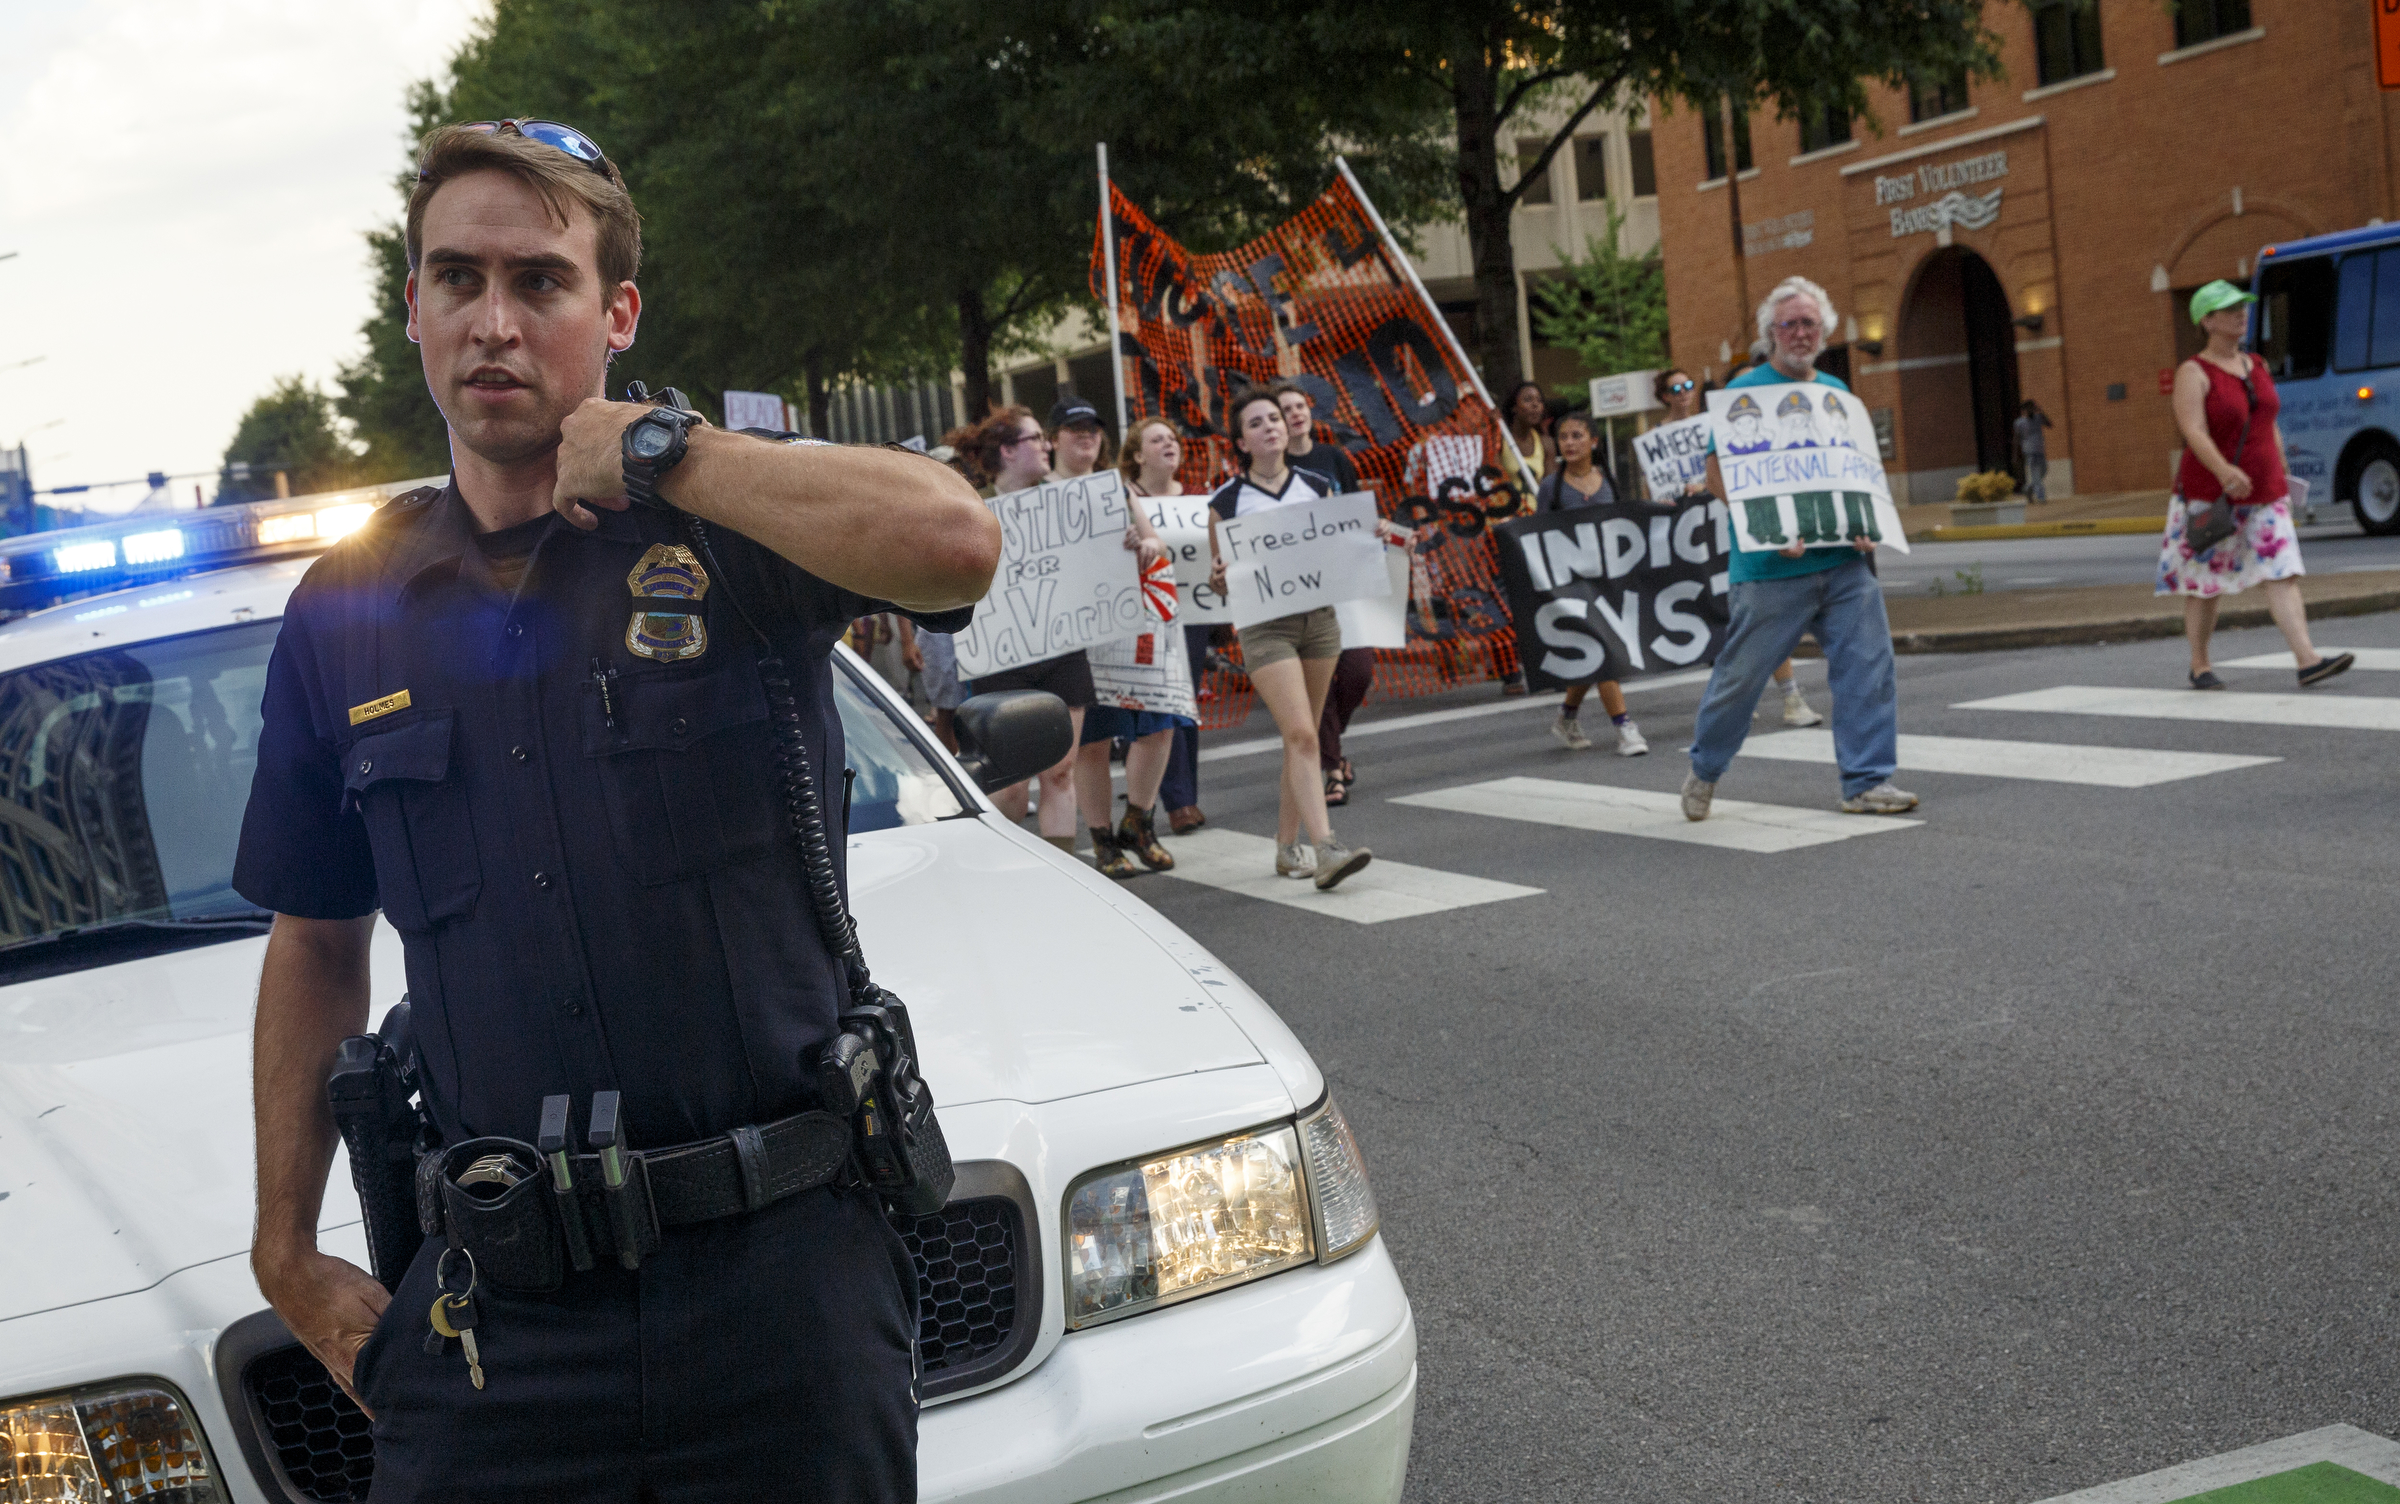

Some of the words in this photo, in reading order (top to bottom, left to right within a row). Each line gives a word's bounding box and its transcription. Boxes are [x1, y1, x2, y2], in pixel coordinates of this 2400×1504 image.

[1642, 423, 1708, 463] WHERE
[1724, 452, 1838, 494] INTERNAL
[1225, 511, 1362, 561] Freedom
[1005, 555, 1060, 587] FOR
[1254, 565, 1322, 603] Now
[956, 578, 1145, 677] JaVario
[1534, 570, 1731, 681] SYS
[364, 699, 395, 716] HOLMES
